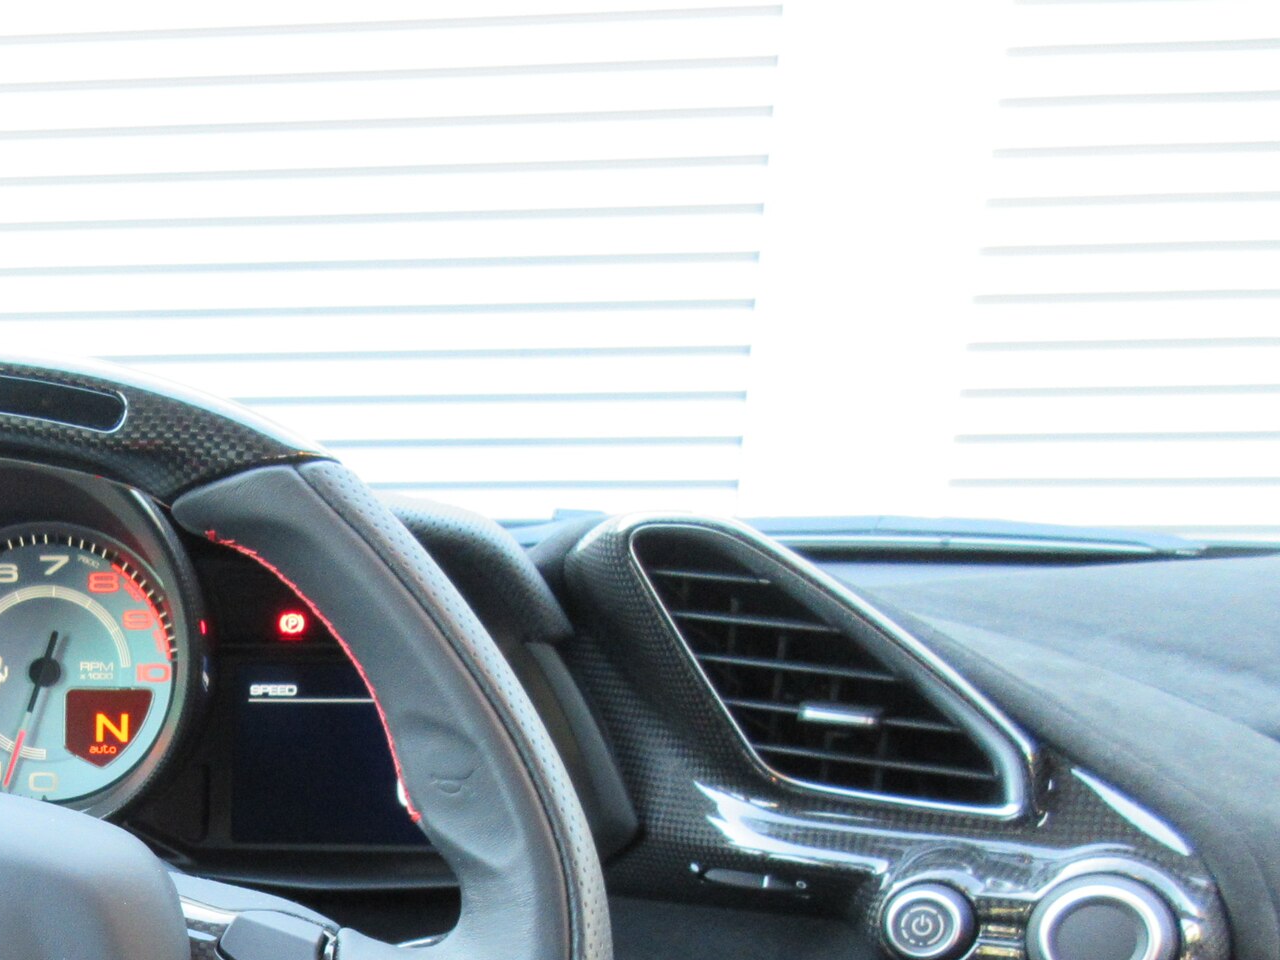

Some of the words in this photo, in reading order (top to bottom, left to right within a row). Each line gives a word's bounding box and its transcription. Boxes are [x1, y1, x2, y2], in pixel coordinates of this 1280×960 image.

[39, 555, 70, 576] 7
[87, 571, 120, 593] 8
[122, 610, 154, 630] 9
[79, 661, 114, 671] RPM
[136, 663, 172, 683] 10
[249, 684, 298, 697] SPEED
[95, 713, 129, 743] N
[89, 744, 117, 755] auto
[28, 771, 59, 792] 0
